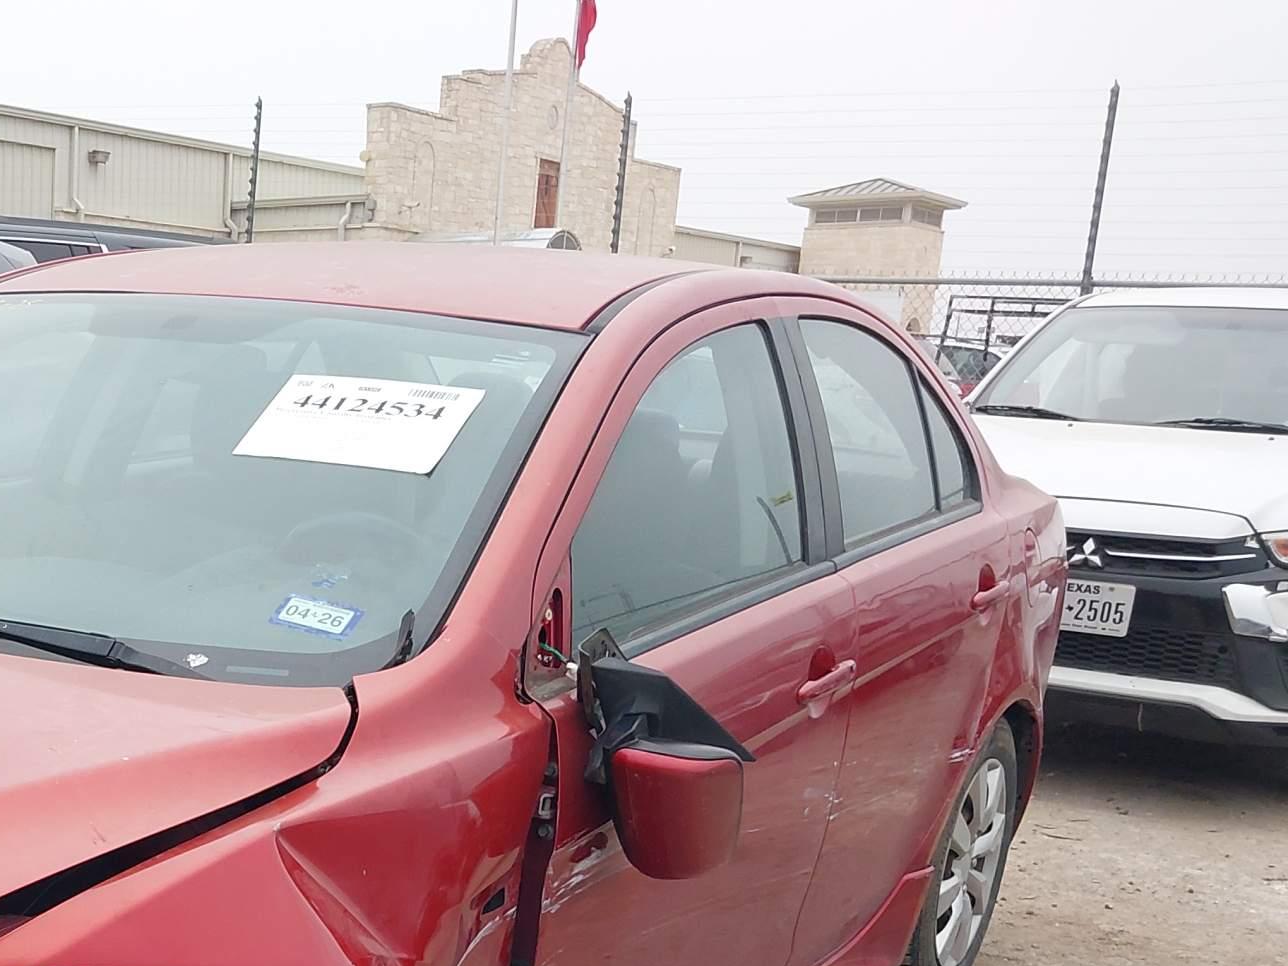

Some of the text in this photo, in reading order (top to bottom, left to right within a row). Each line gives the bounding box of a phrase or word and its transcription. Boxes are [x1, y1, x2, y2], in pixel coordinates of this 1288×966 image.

[293, 394, 447, 421] 44124534
[1066, 583, 1101, 595] EXAS
[1074, 598, 1126, 625] 2505
